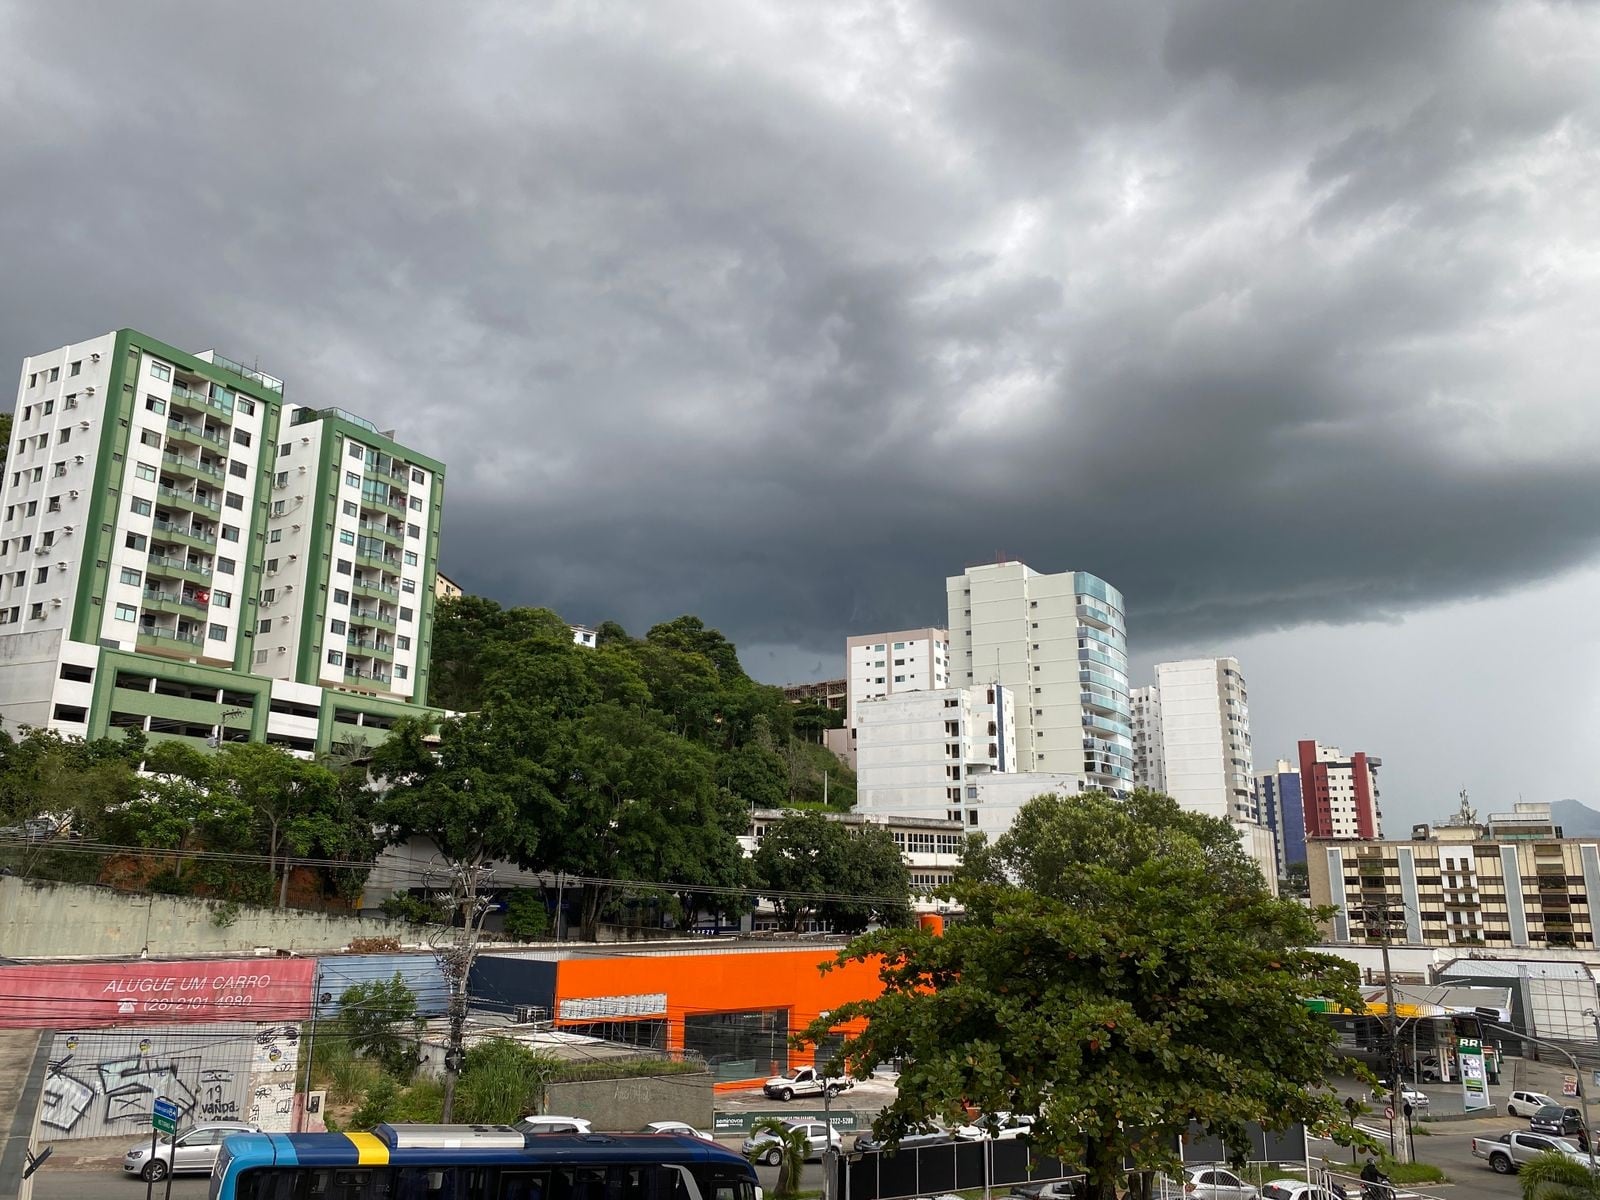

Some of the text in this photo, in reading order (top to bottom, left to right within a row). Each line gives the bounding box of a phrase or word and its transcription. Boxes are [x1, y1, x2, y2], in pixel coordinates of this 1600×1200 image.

[103, 974, 271, 993] ALUGUE UM CARRO
